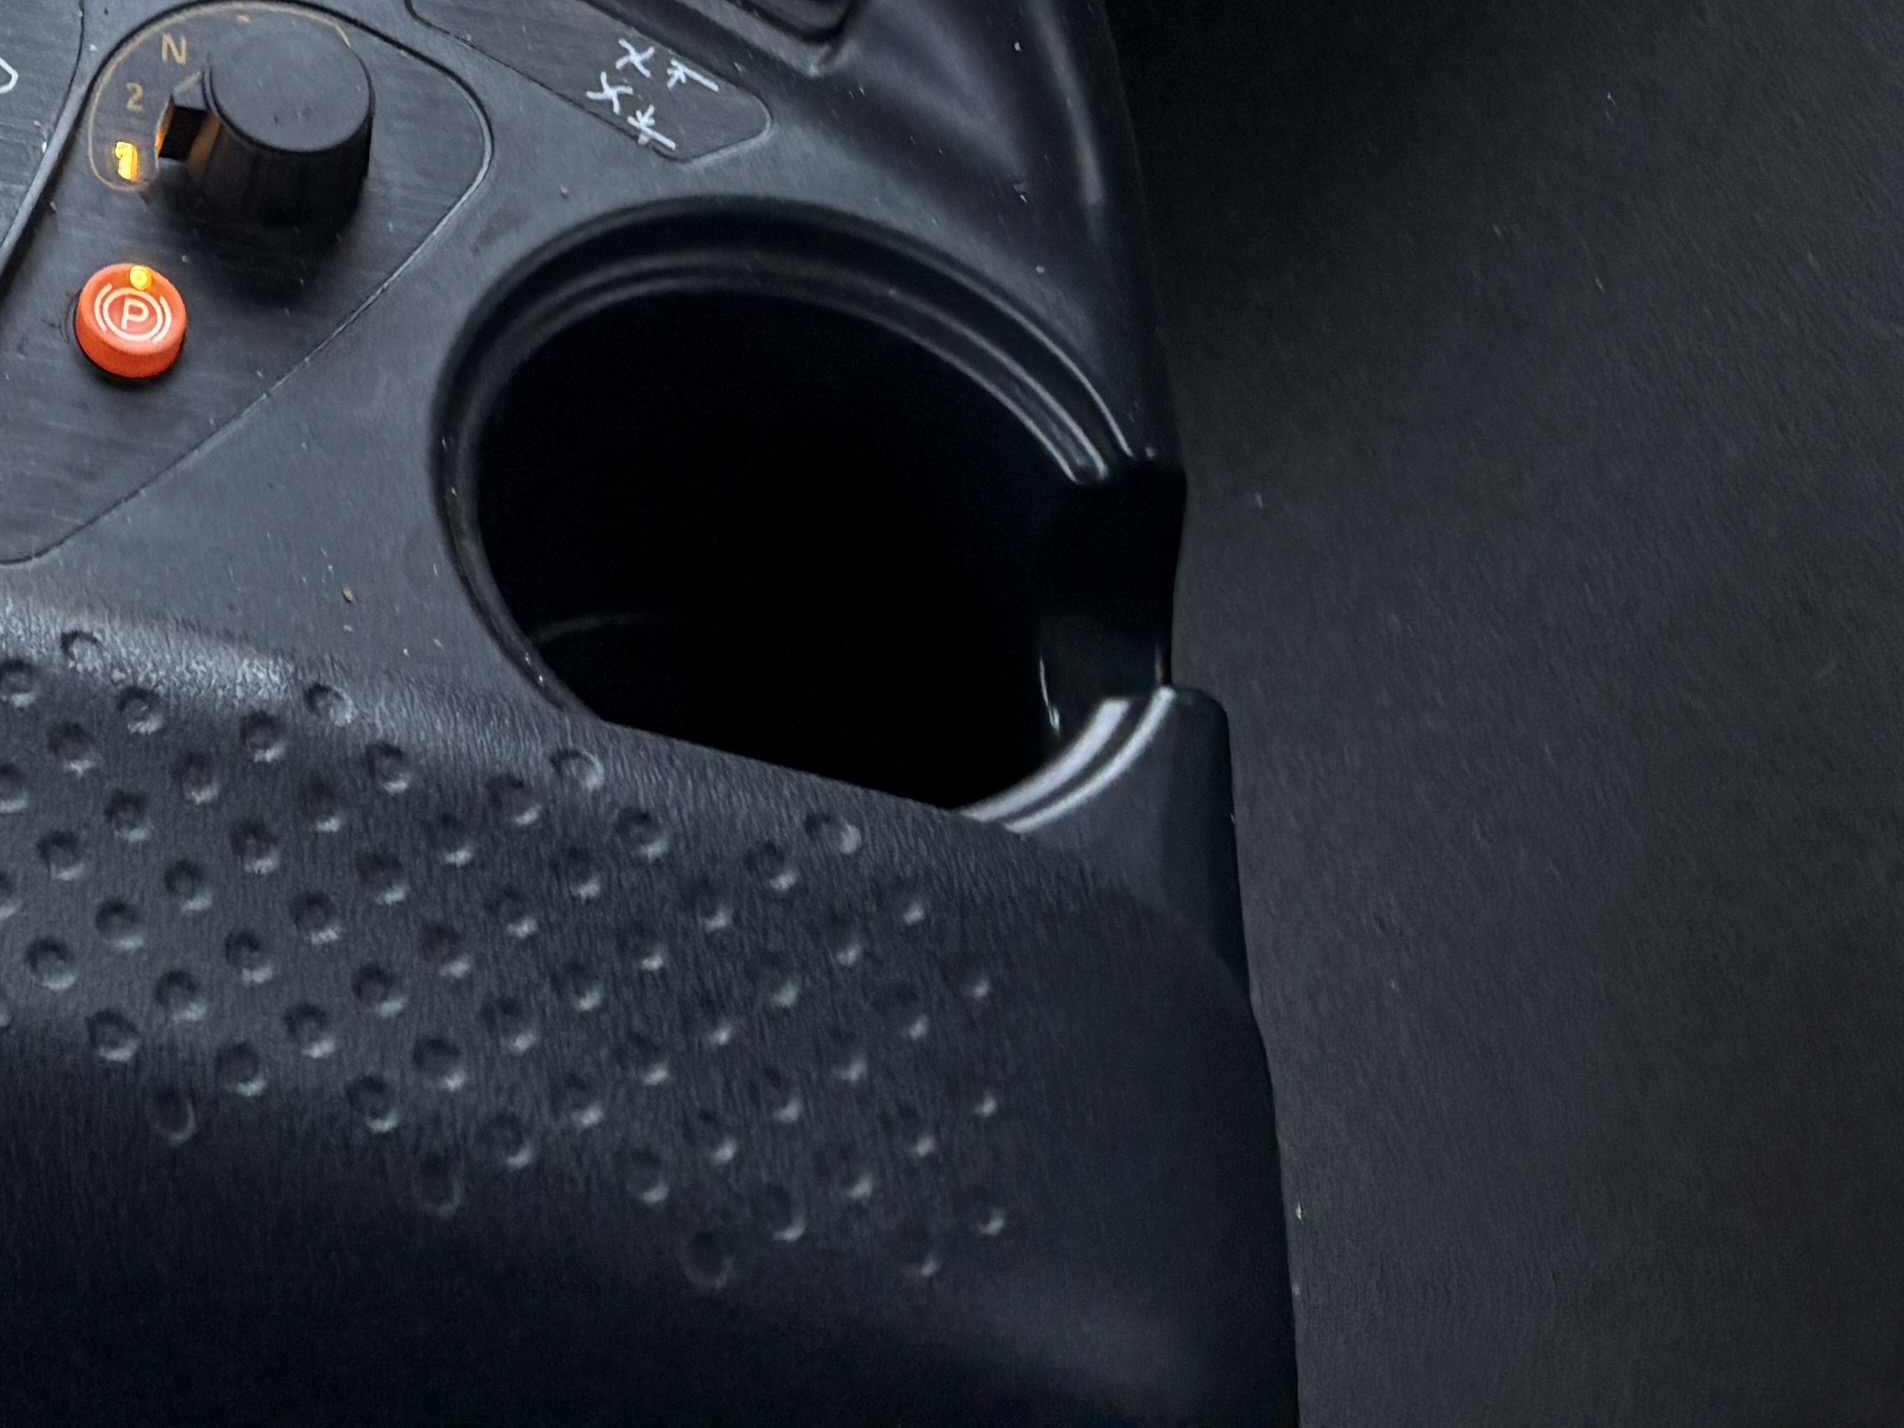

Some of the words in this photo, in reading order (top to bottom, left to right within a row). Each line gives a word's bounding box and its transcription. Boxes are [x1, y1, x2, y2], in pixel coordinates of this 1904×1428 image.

[161, 33, 188, 65] N
[125, 82, 145, 113] 2
[114, 141, 139, 183] 1
[121, 297, 149, 330] P
